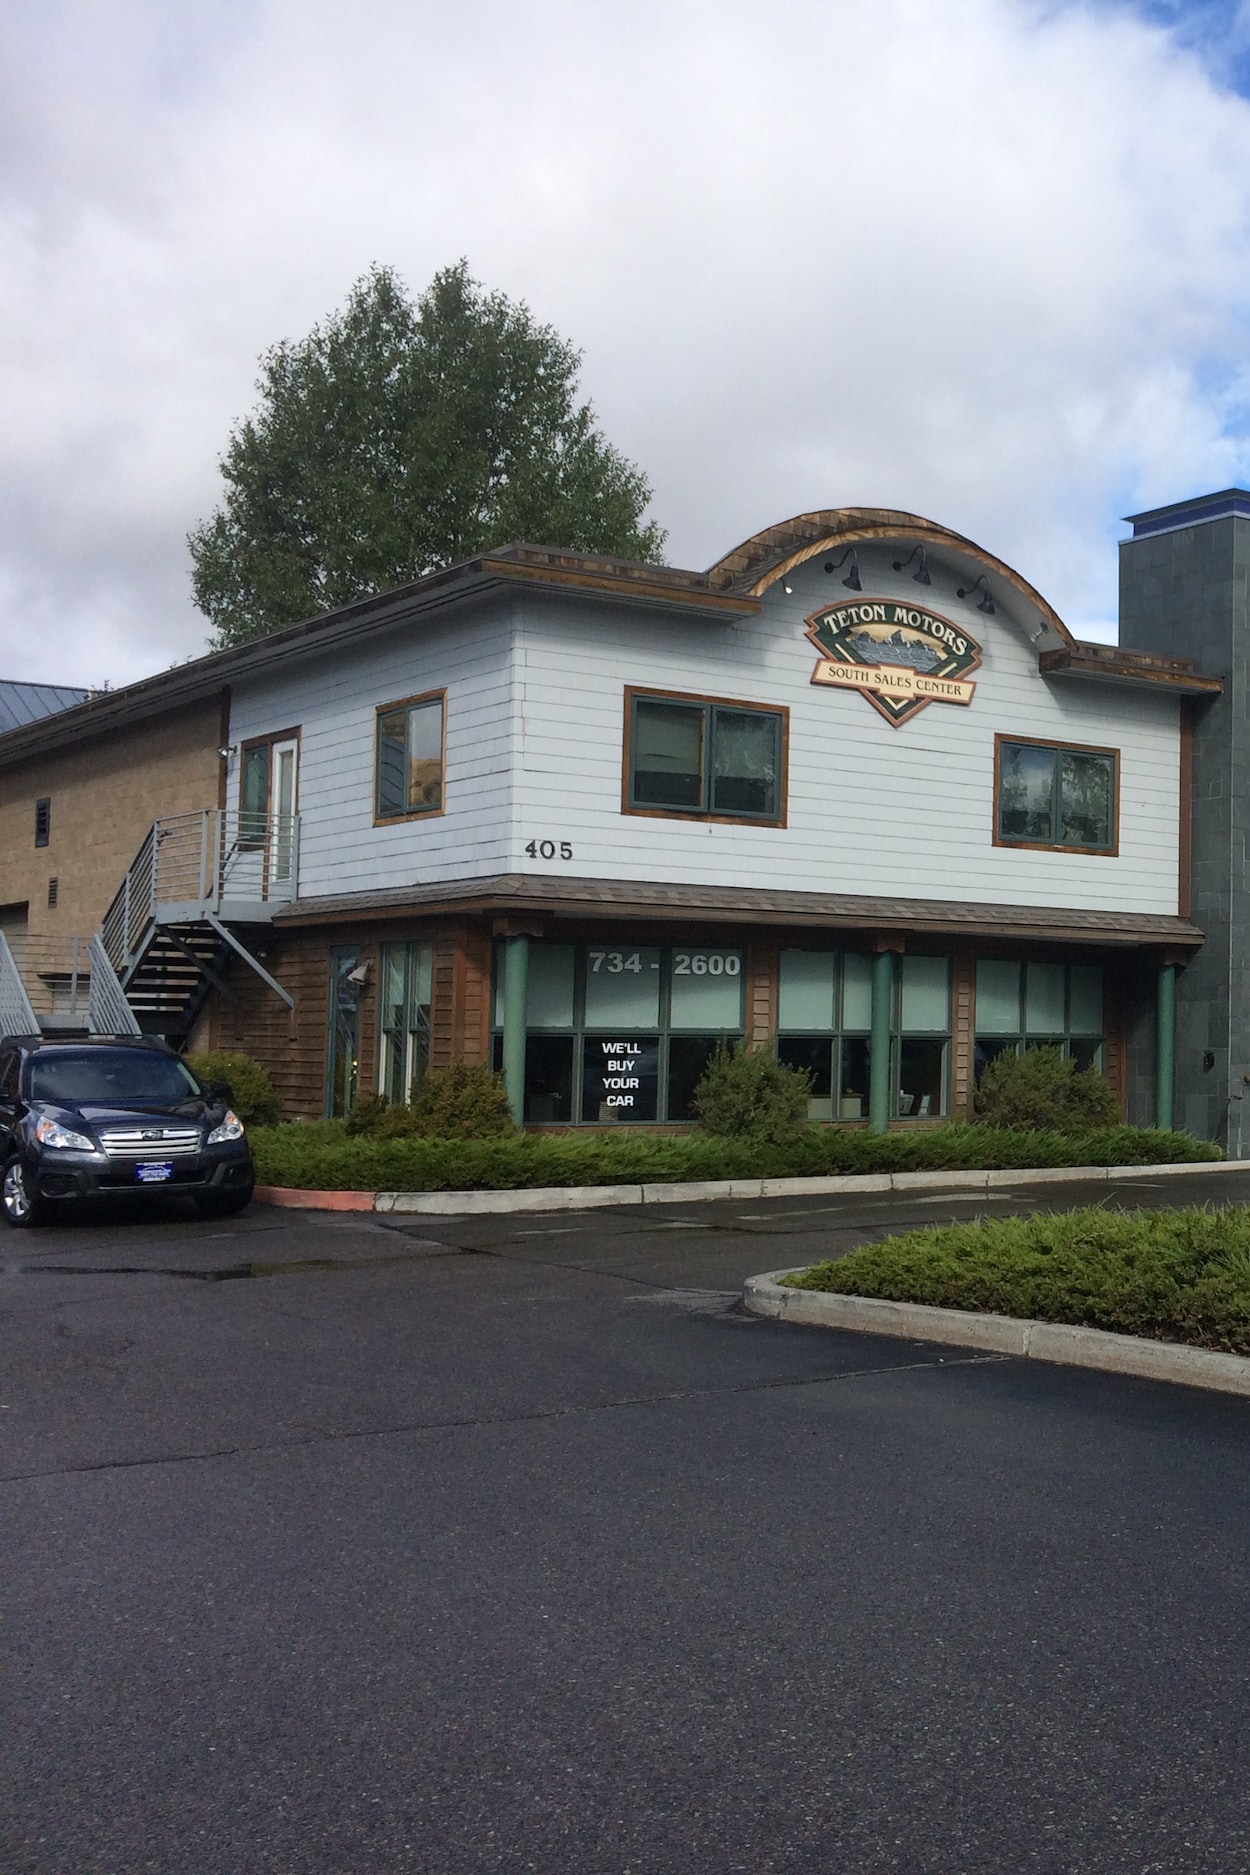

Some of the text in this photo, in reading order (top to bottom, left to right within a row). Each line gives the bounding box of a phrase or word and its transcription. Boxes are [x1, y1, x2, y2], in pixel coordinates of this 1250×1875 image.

[824, 605, 968, 656] TETON MOTORS
[828, 666, 962, 696] SOUTH SALES CENTER
[525, 840, 573, 860] 405
[589, 952, 642, 973] 734
[674, 955, 741, 976] 2600
[602, 1043, 642, 1054] WE'LL
[607, 1060, 636, 1072] BUY
[602, 1077, 640, 1089] YOUR
[606, 1095, 635, 1107] CAR
